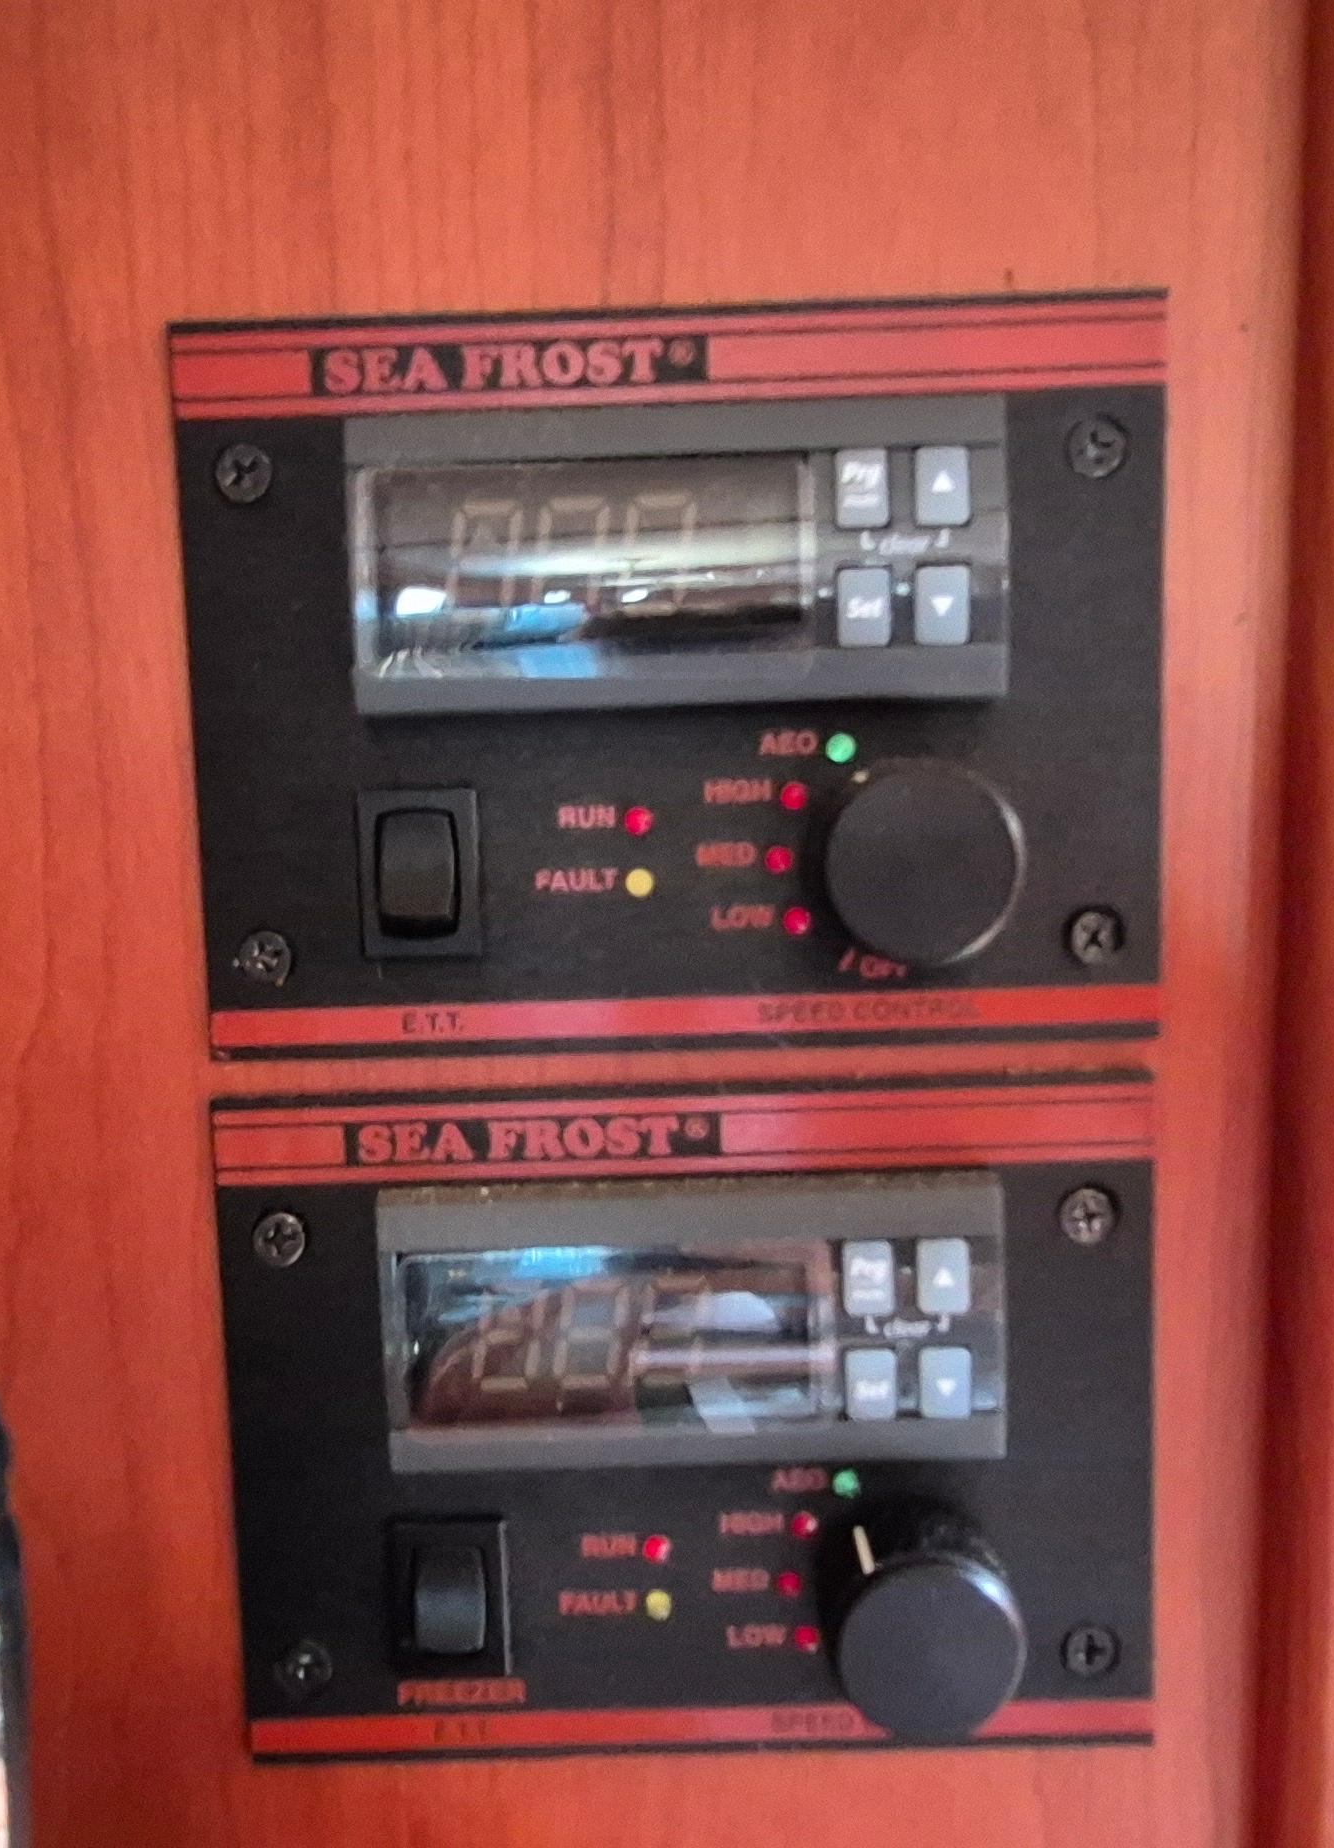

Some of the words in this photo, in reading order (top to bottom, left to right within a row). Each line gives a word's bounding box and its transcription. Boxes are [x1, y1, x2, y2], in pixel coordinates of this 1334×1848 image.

[324, 347, 448, 395] SEA
[704, 778, 773, 804] HIGH
[557, 805, 616, 830] RUN
[695, 842, 757, 868] MED
[535, 867, 618, 893] FAULT
[710, 905, 774, 931] LOW
[758, 1000, 845, 1024] SPEED
[358, 1121, 474, 1165] SEA
[718, 1512, 784, 1535] HIGH
[581, 1533, 637, 1559] RUN
[711, 1569, 770, 1593] MED
[559, 1590, 639, 1616] FAULT
[726, 1624, 788, 1648] LOW
[397, 1677, 528, 1708] FREEZER
[771, 1708, 854, 1733] SPEED
